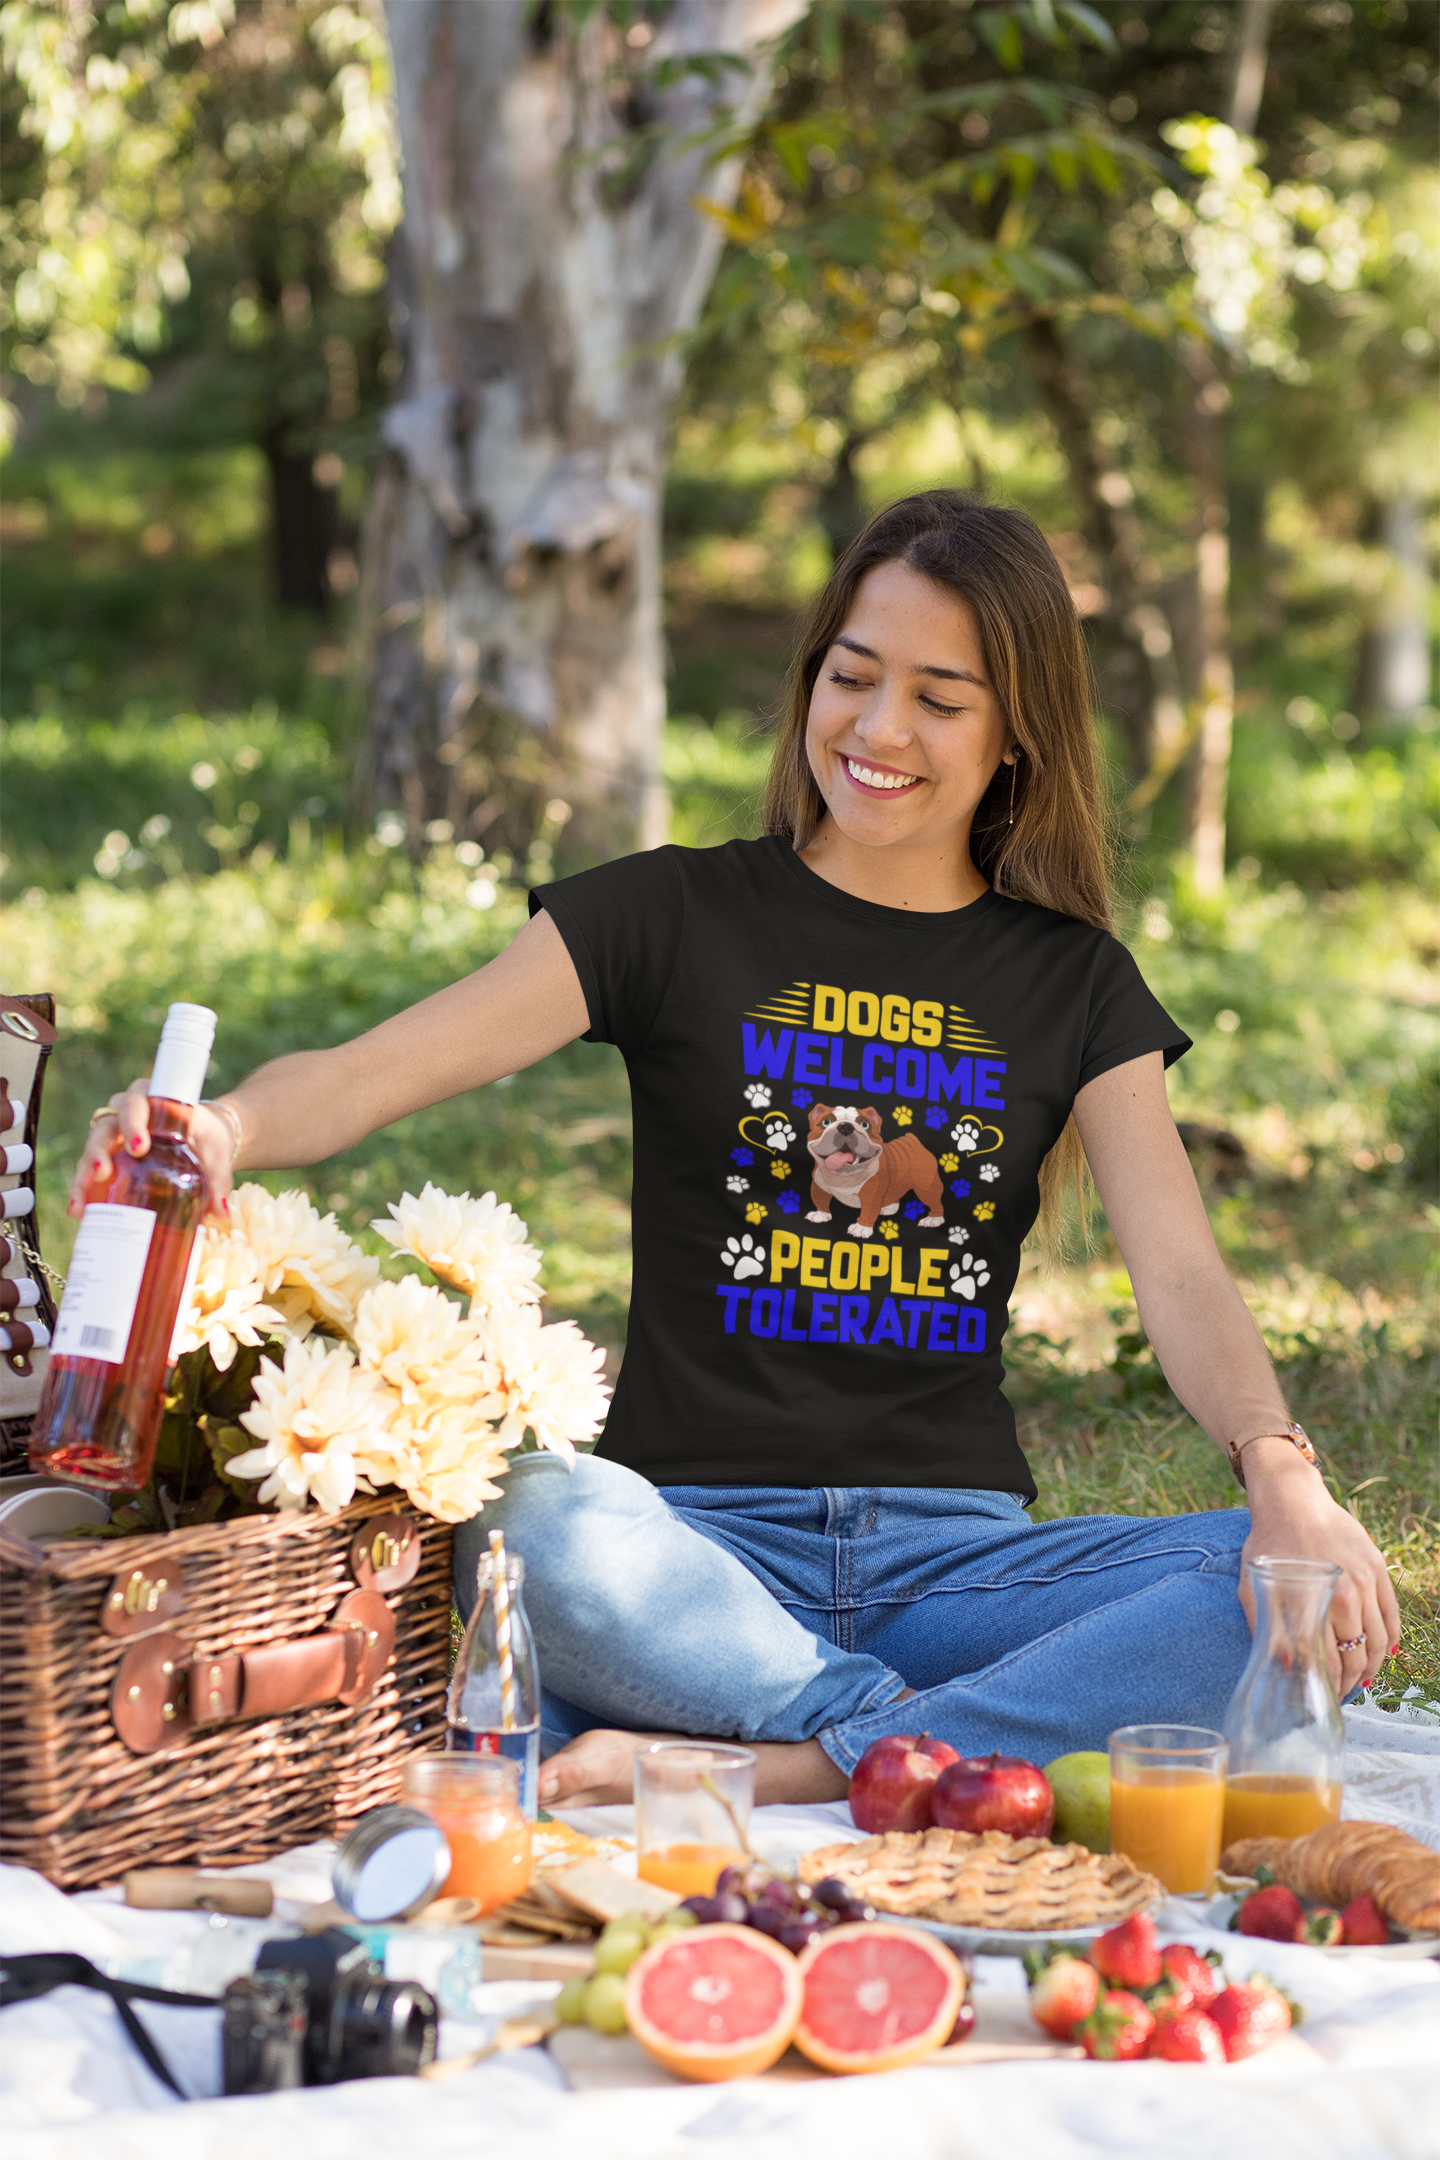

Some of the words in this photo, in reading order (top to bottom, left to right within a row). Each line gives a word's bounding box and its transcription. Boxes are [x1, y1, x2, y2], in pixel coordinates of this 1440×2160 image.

[813, 984, 944, 1047] DOGS
[742, 1022, 1007, 1110] WELCOME
[770, 1229, 949, 1297] PEOPLE
[716, 1284, 987, 1353] TOLERATED
